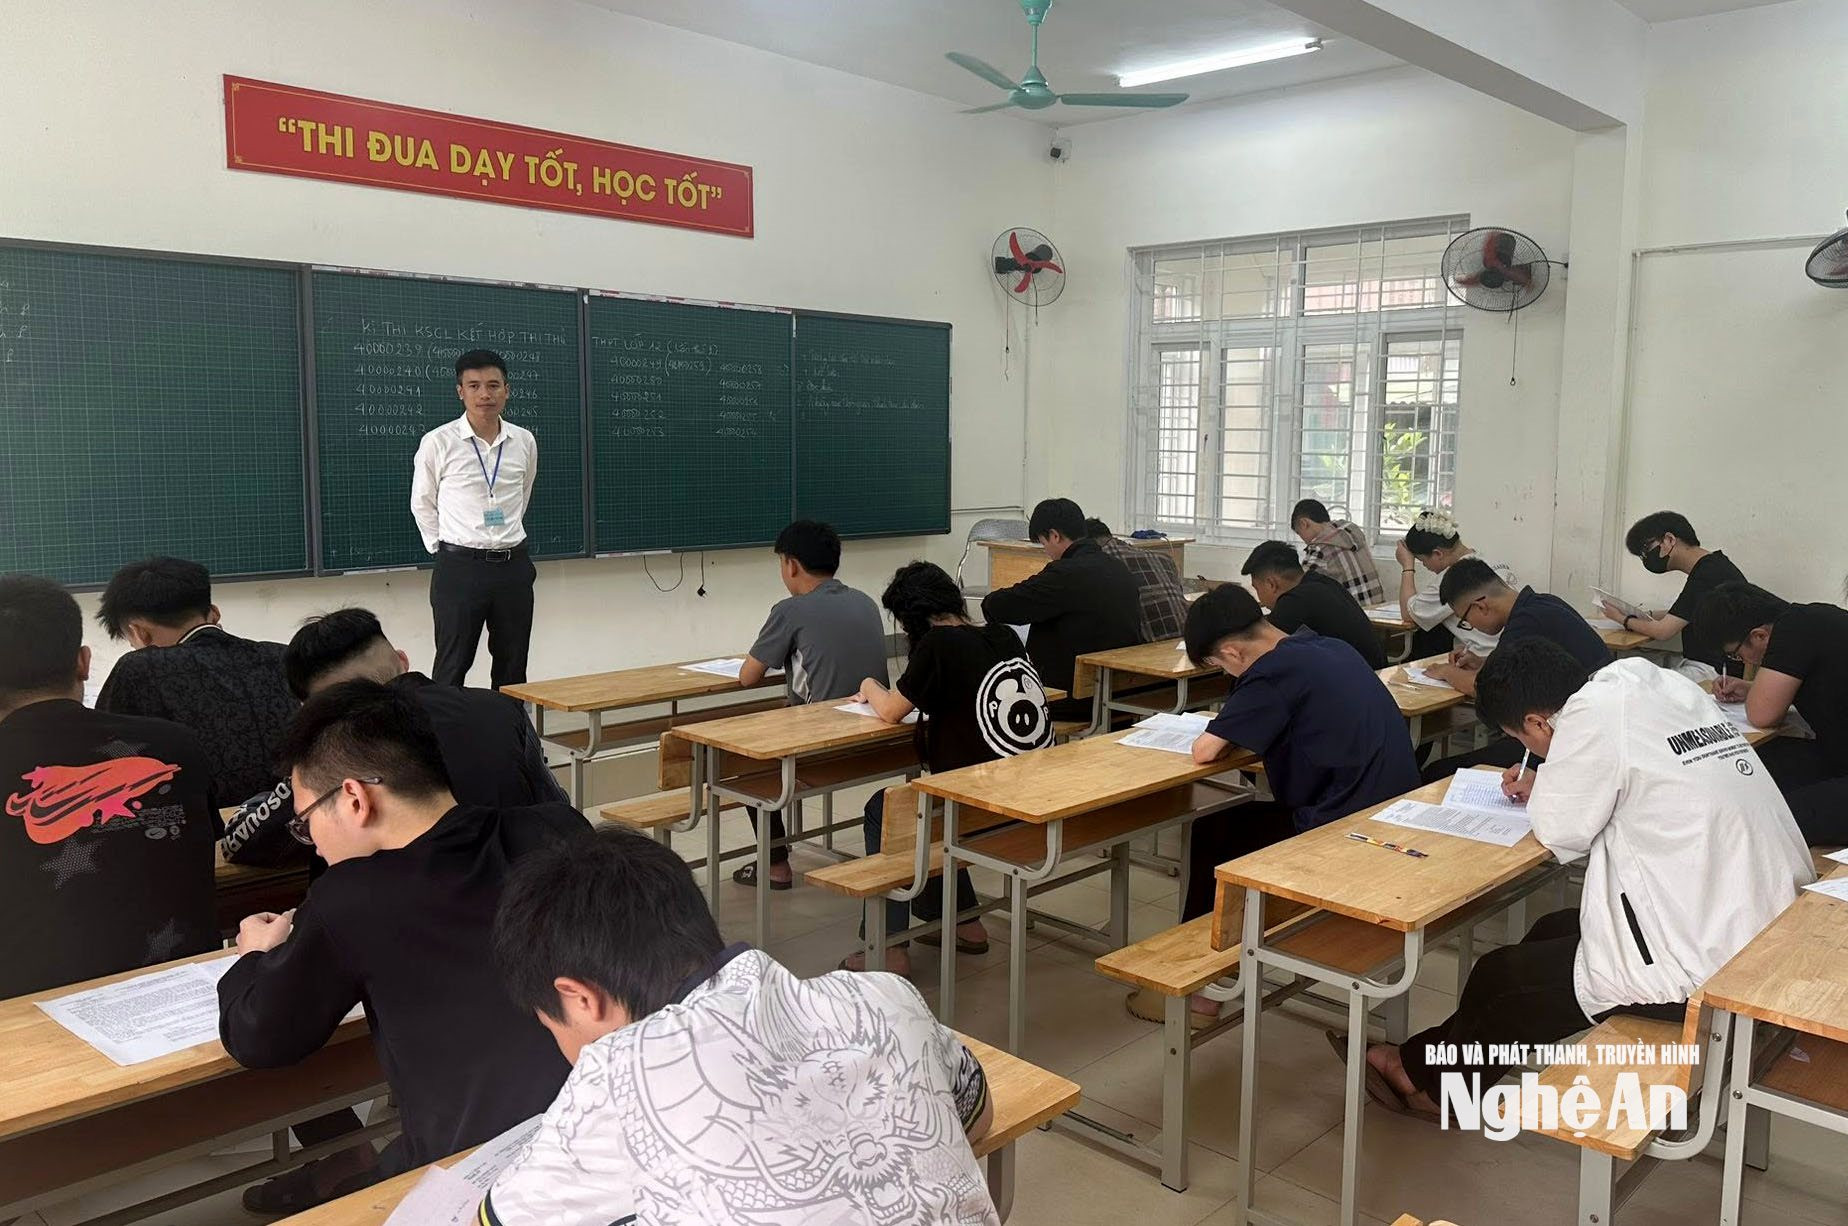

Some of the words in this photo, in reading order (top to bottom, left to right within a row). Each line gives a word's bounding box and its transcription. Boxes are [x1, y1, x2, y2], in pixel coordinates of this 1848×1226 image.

[367, 133, 439, 171] ĐUA
[449, 143, 514, 186] DẠY
[525, 147, 583, 196] TỐT,
[592, 167, 656, 204] HỌC
[382, 321, 407, 337] THI
[415, 322, 453, 340] KSCL
[519, 331, 543, 344] THI
